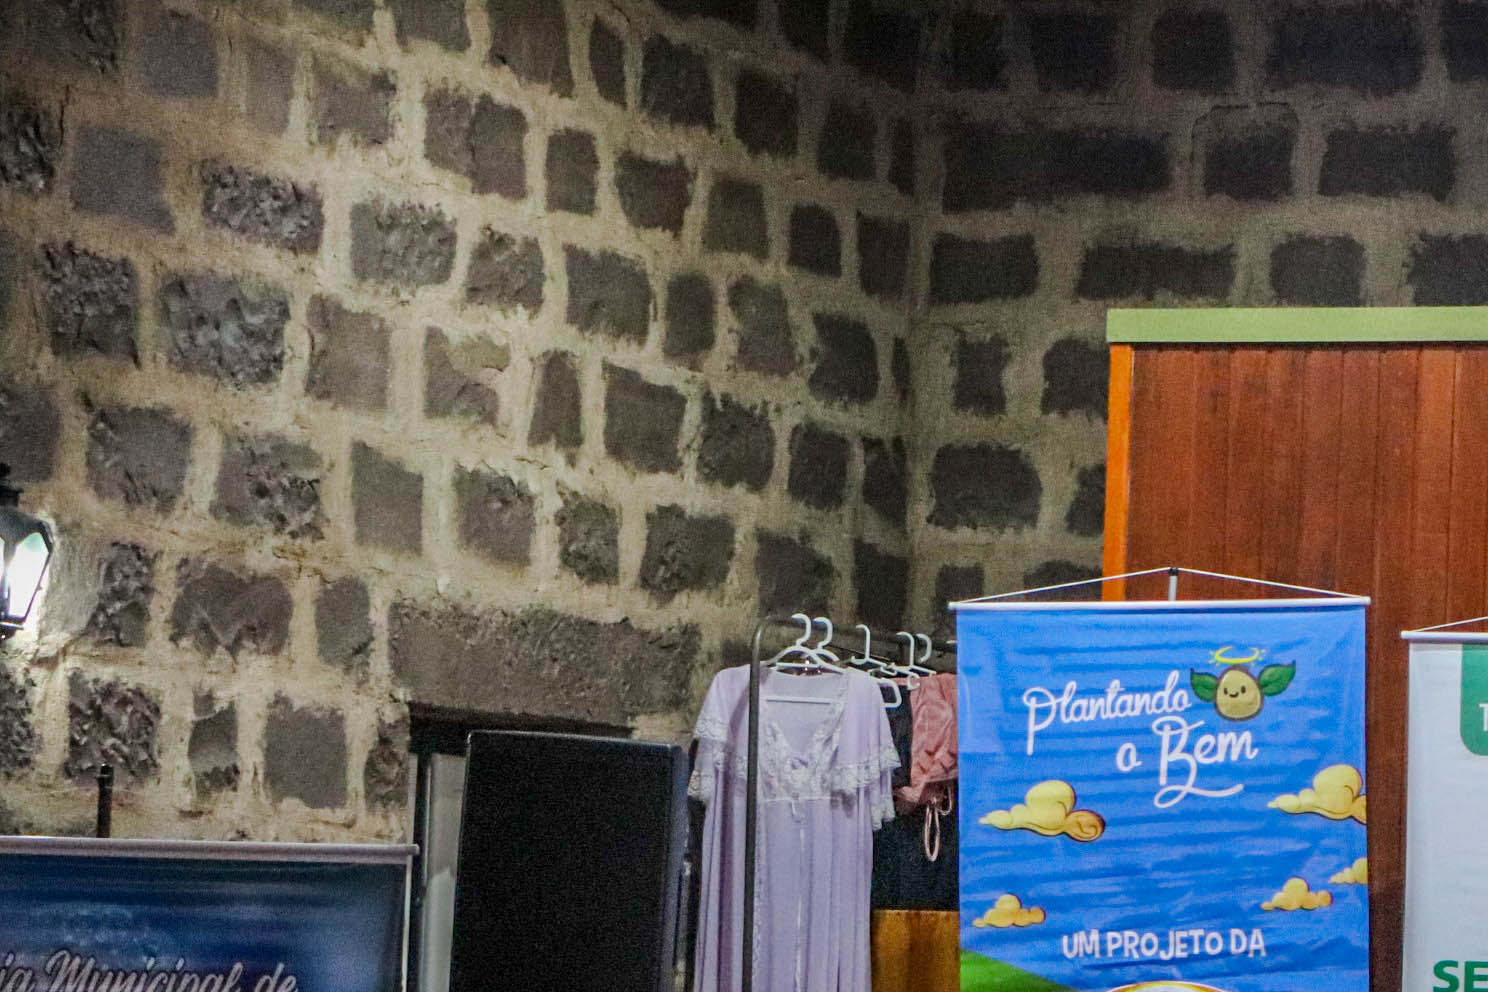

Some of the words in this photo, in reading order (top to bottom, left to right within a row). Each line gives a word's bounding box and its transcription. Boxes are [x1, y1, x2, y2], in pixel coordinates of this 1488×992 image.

[1023, 670, 1192, 756] Plantando
[1152, 715, 1259, 808] Bem
[1062, 929, 1100, 958] UM
[1107, 928, 1223, 961] PROJETO
[1230, 928, 1267, 957] DA
